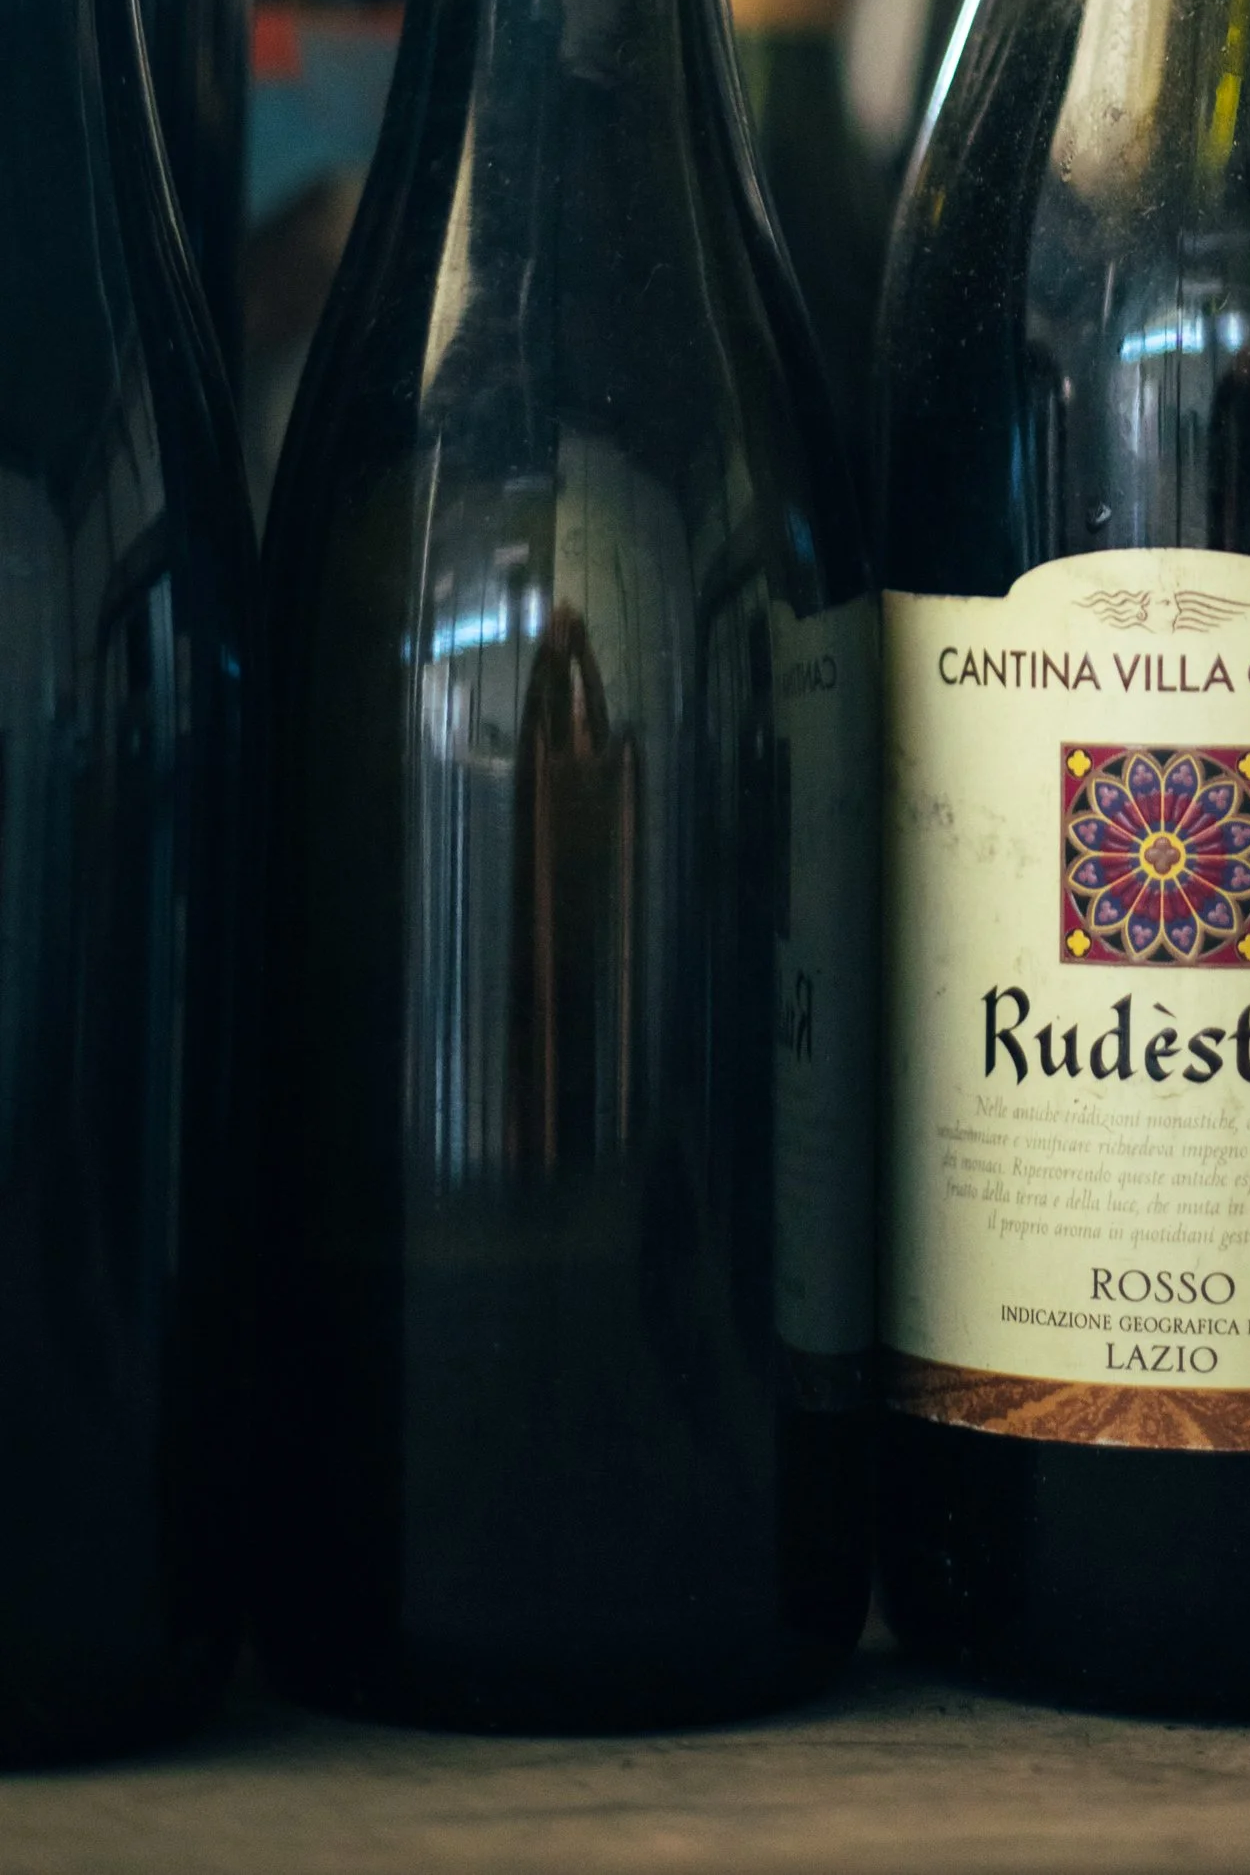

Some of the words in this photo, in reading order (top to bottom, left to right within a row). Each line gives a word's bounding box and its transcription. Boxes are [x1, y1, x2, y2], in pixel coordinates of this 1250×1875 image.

[939, 646, 1101, 691] CANTINA
[1113, 653, 1234, 693] VILLA
[975, 1094, 1008, 1119] Nelle
[1013, 1100, 1058, 1125] antiche
[1065, 1104, 1140, 1133] tradizioni
[1026, 1132, 1091, 1159] vinificare
[1098, 1135, 1174, 1157] richiedeva
[1181, 1143, 1248, 1165] impegno
[1013, 1155, 1111, 1187] Ripercorrendo
[1118, 1168, 1167, 1192] queste
[1172, 1167, 1228, 1189] antiche
[981, 1180, 1011, 1205] della
[1015, 1189, 1048, 1208] terra
[1065, 1187, 1101, 1213] della
[1146, 1192, 1170, 1216] che
[1177, 1198, 1220, 1217] muta
[1228, 1196, 1244, 1217] in
[988, 1210, 997, 1232] il
[1000, 1215, 1050, 1242] proprio
[1054, 1222, 1101, 1241] aroma
[1108, 1221, 1124, 1241] in
[1130, 1221, 1214, 1249] quotidiani
[1090, 1267, 1236, 1306] ROSSO
[1000, 1305, 1112, 1333] INDICAZIONE
[1119, 1312, 1240, 1337] GEOGRAFICA
[1106, 1341, 1219, 1375] LAZIO
